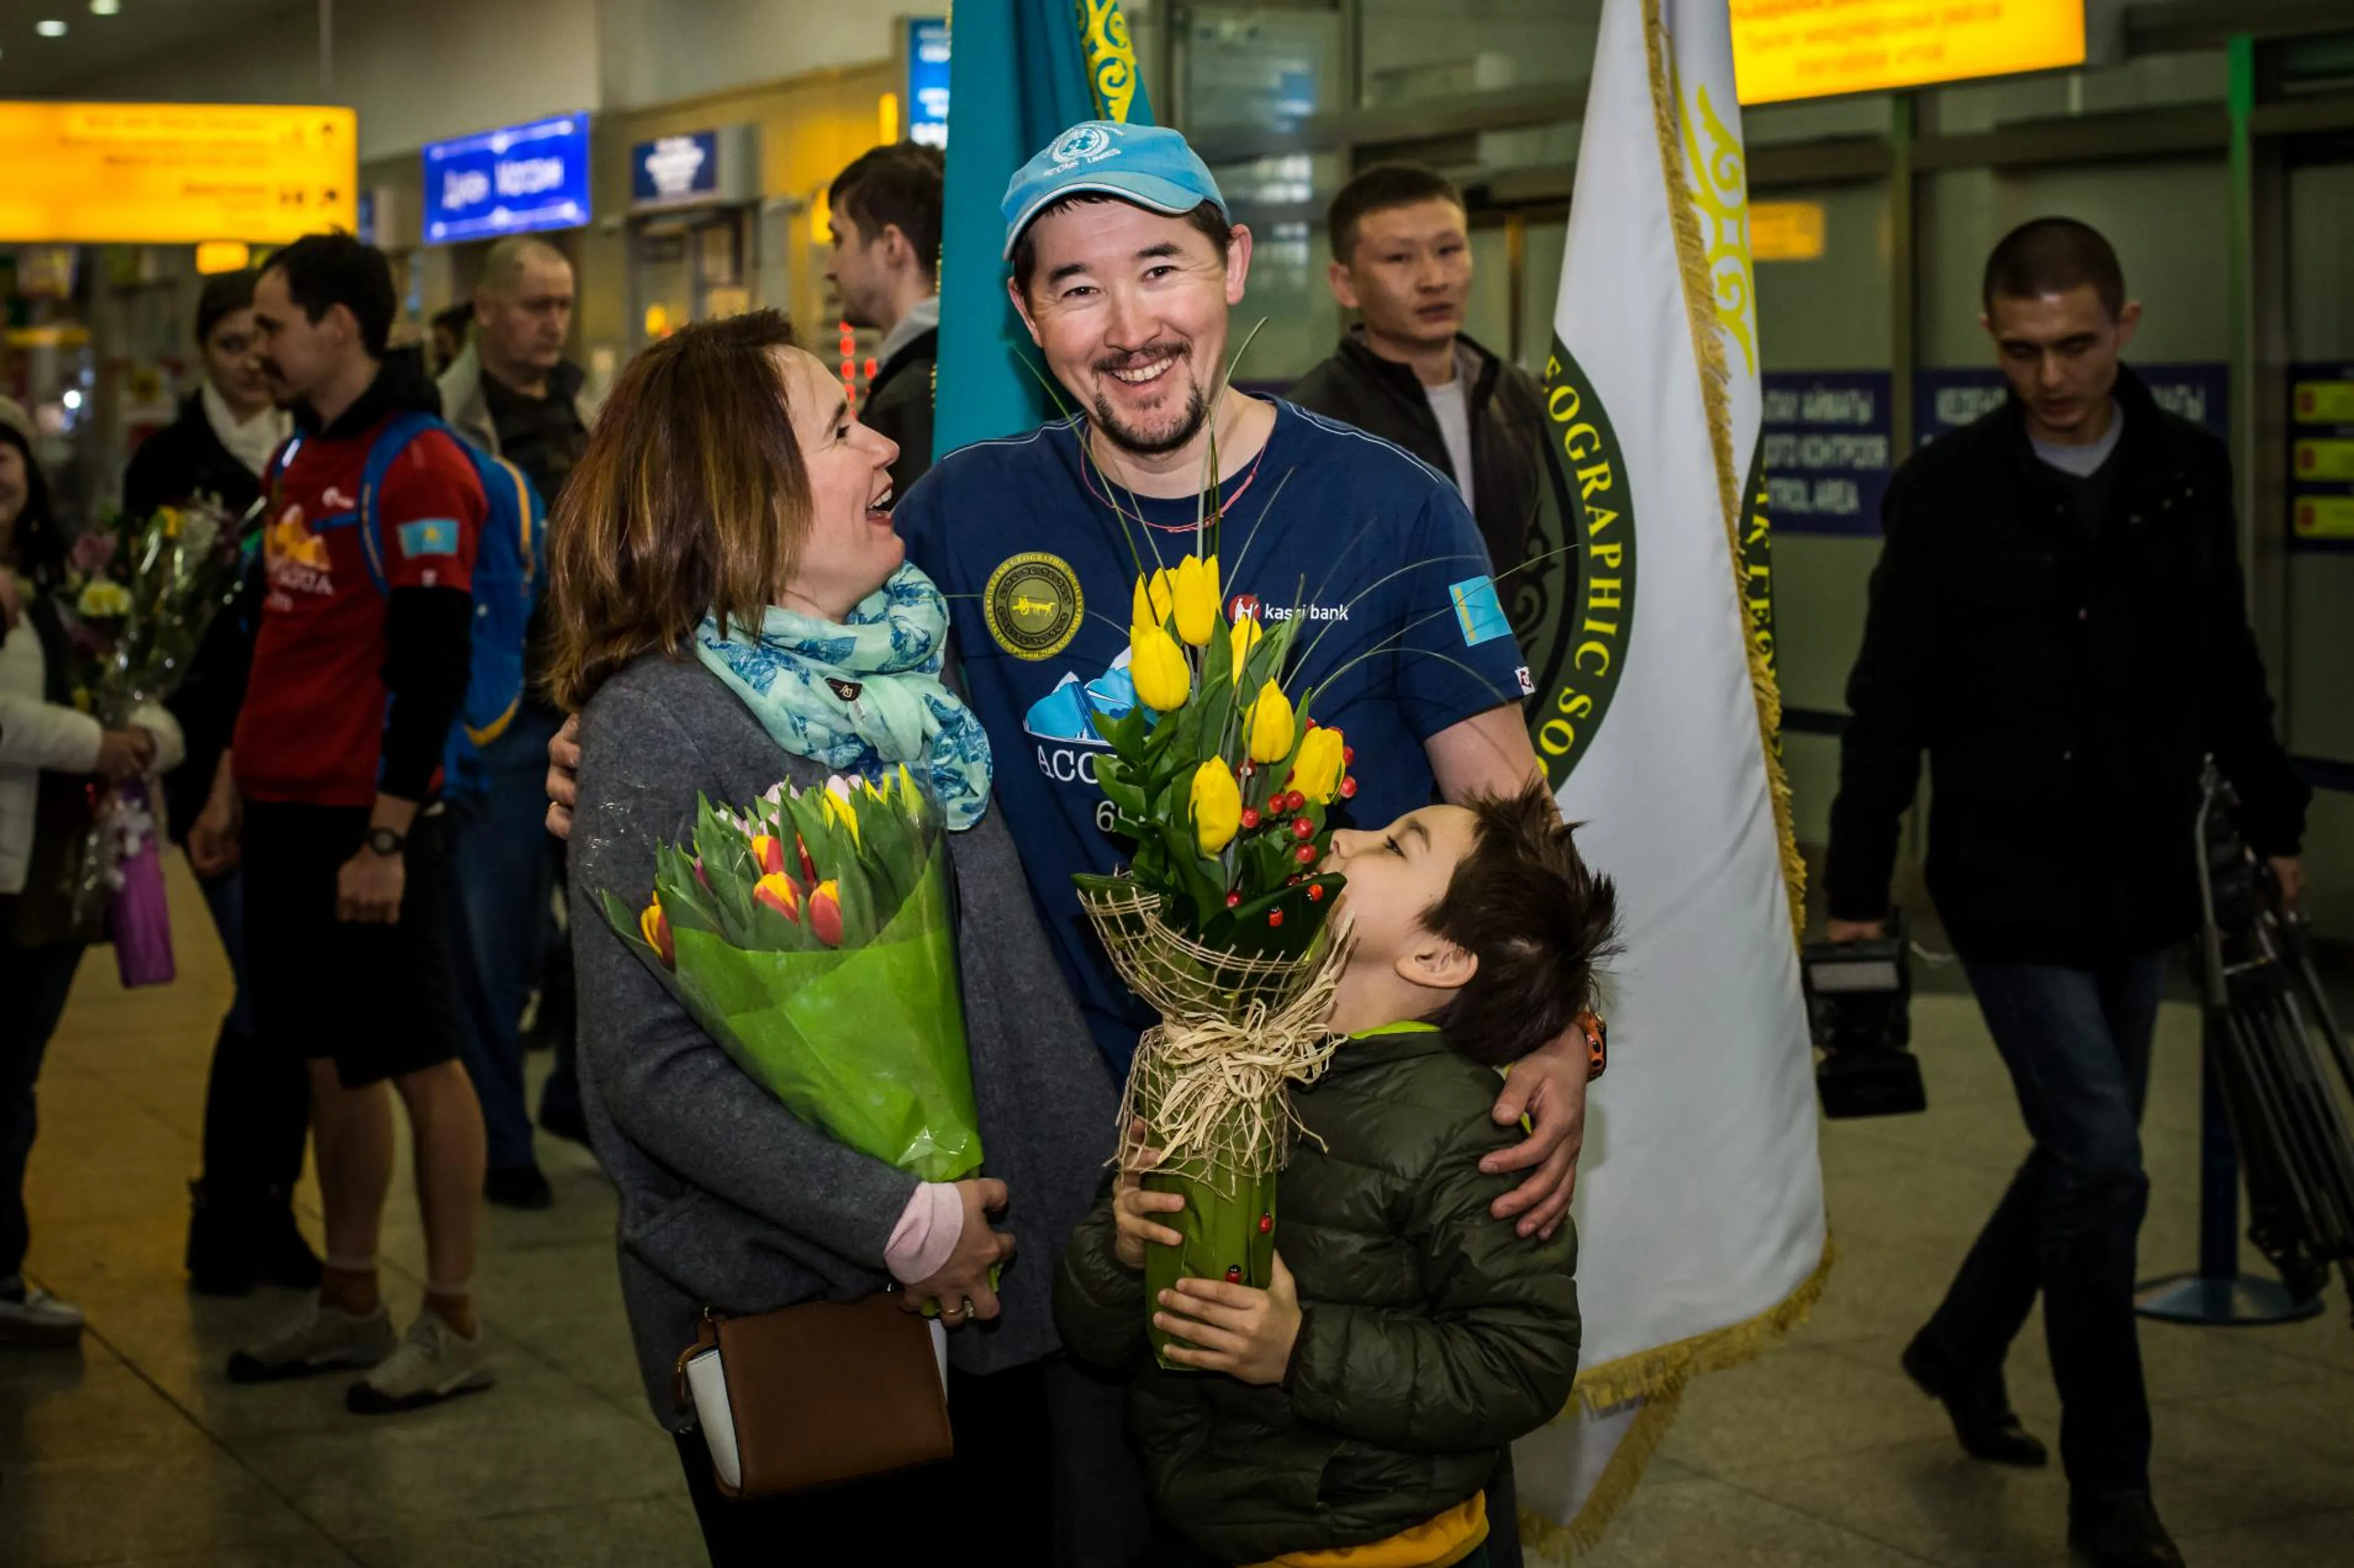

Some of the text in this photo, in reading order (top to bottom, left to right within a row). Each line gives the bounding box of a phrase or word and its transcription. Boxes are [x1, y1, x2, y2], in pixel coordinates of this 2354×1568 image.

[1265, 603, 1349, 620] kasi bank
[1537, 687, 1593, 777] SO
